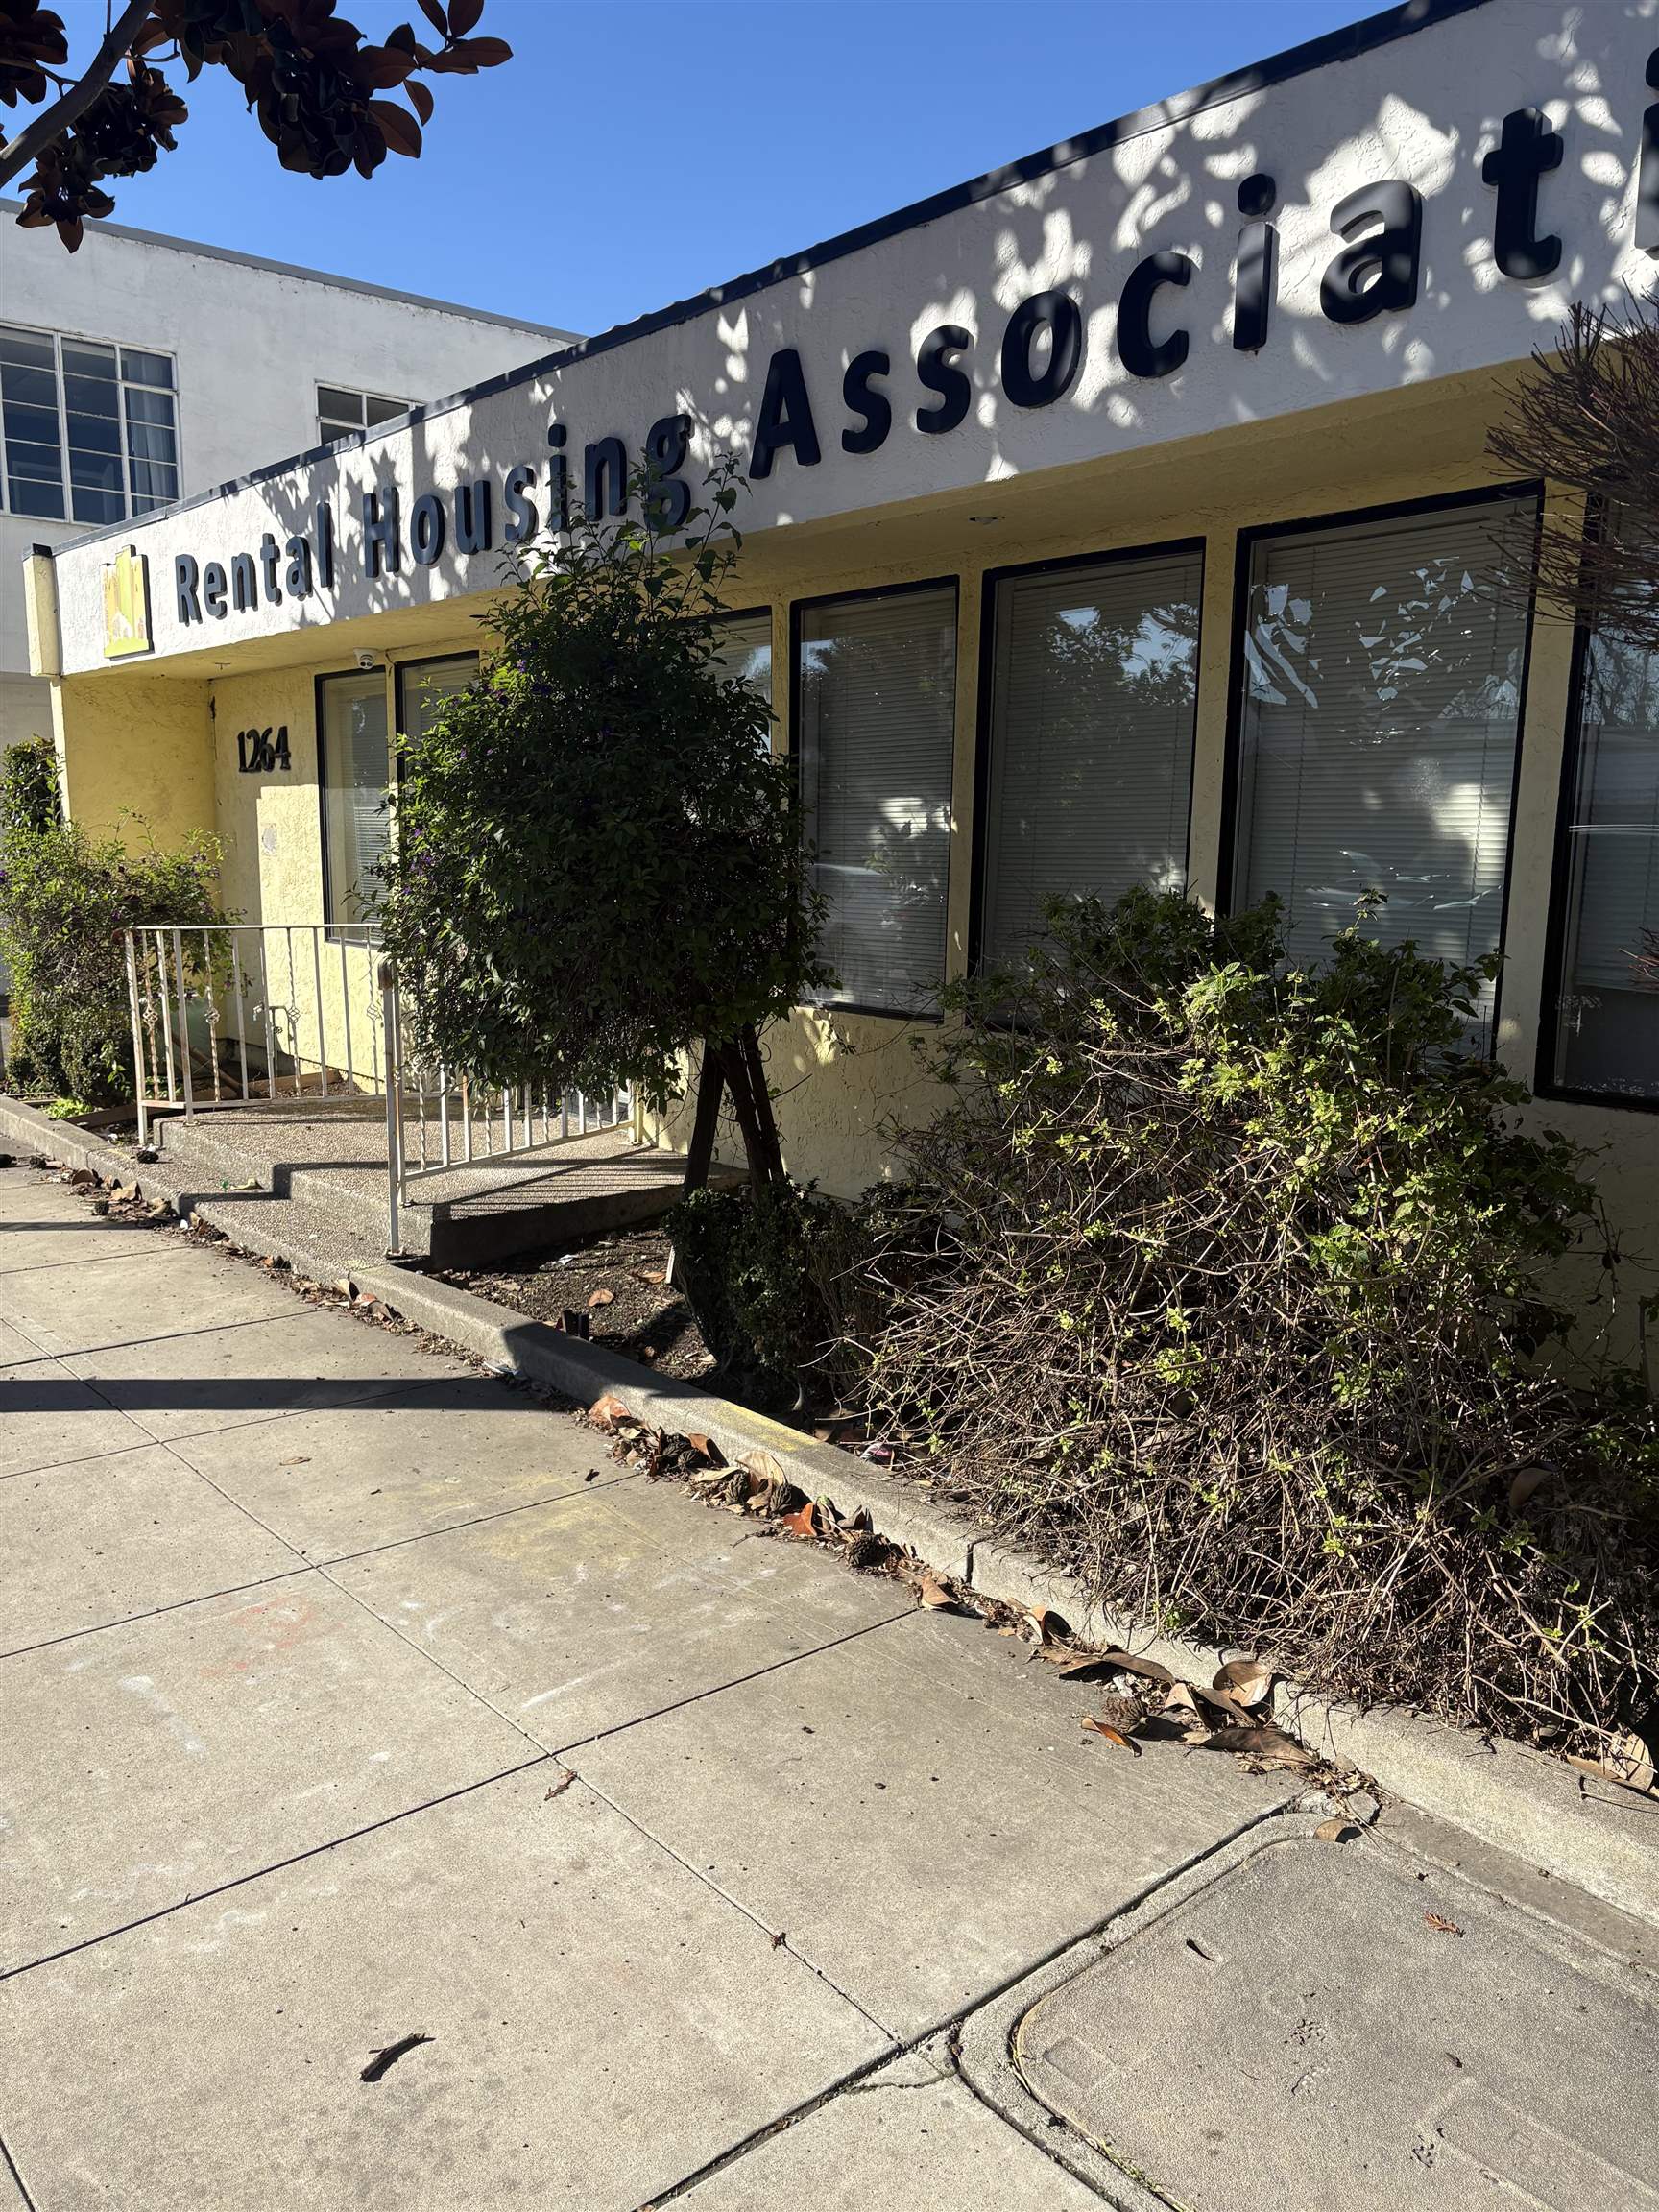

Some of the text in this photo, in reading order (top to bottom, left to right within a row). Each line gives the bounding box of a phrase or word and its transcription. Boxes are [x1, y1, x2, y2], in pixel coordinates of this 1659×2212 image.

[175, 502, 335, 627] Rental
[363, 414, 692, 578] Housing
[237, 726, 292, 773] 1264
